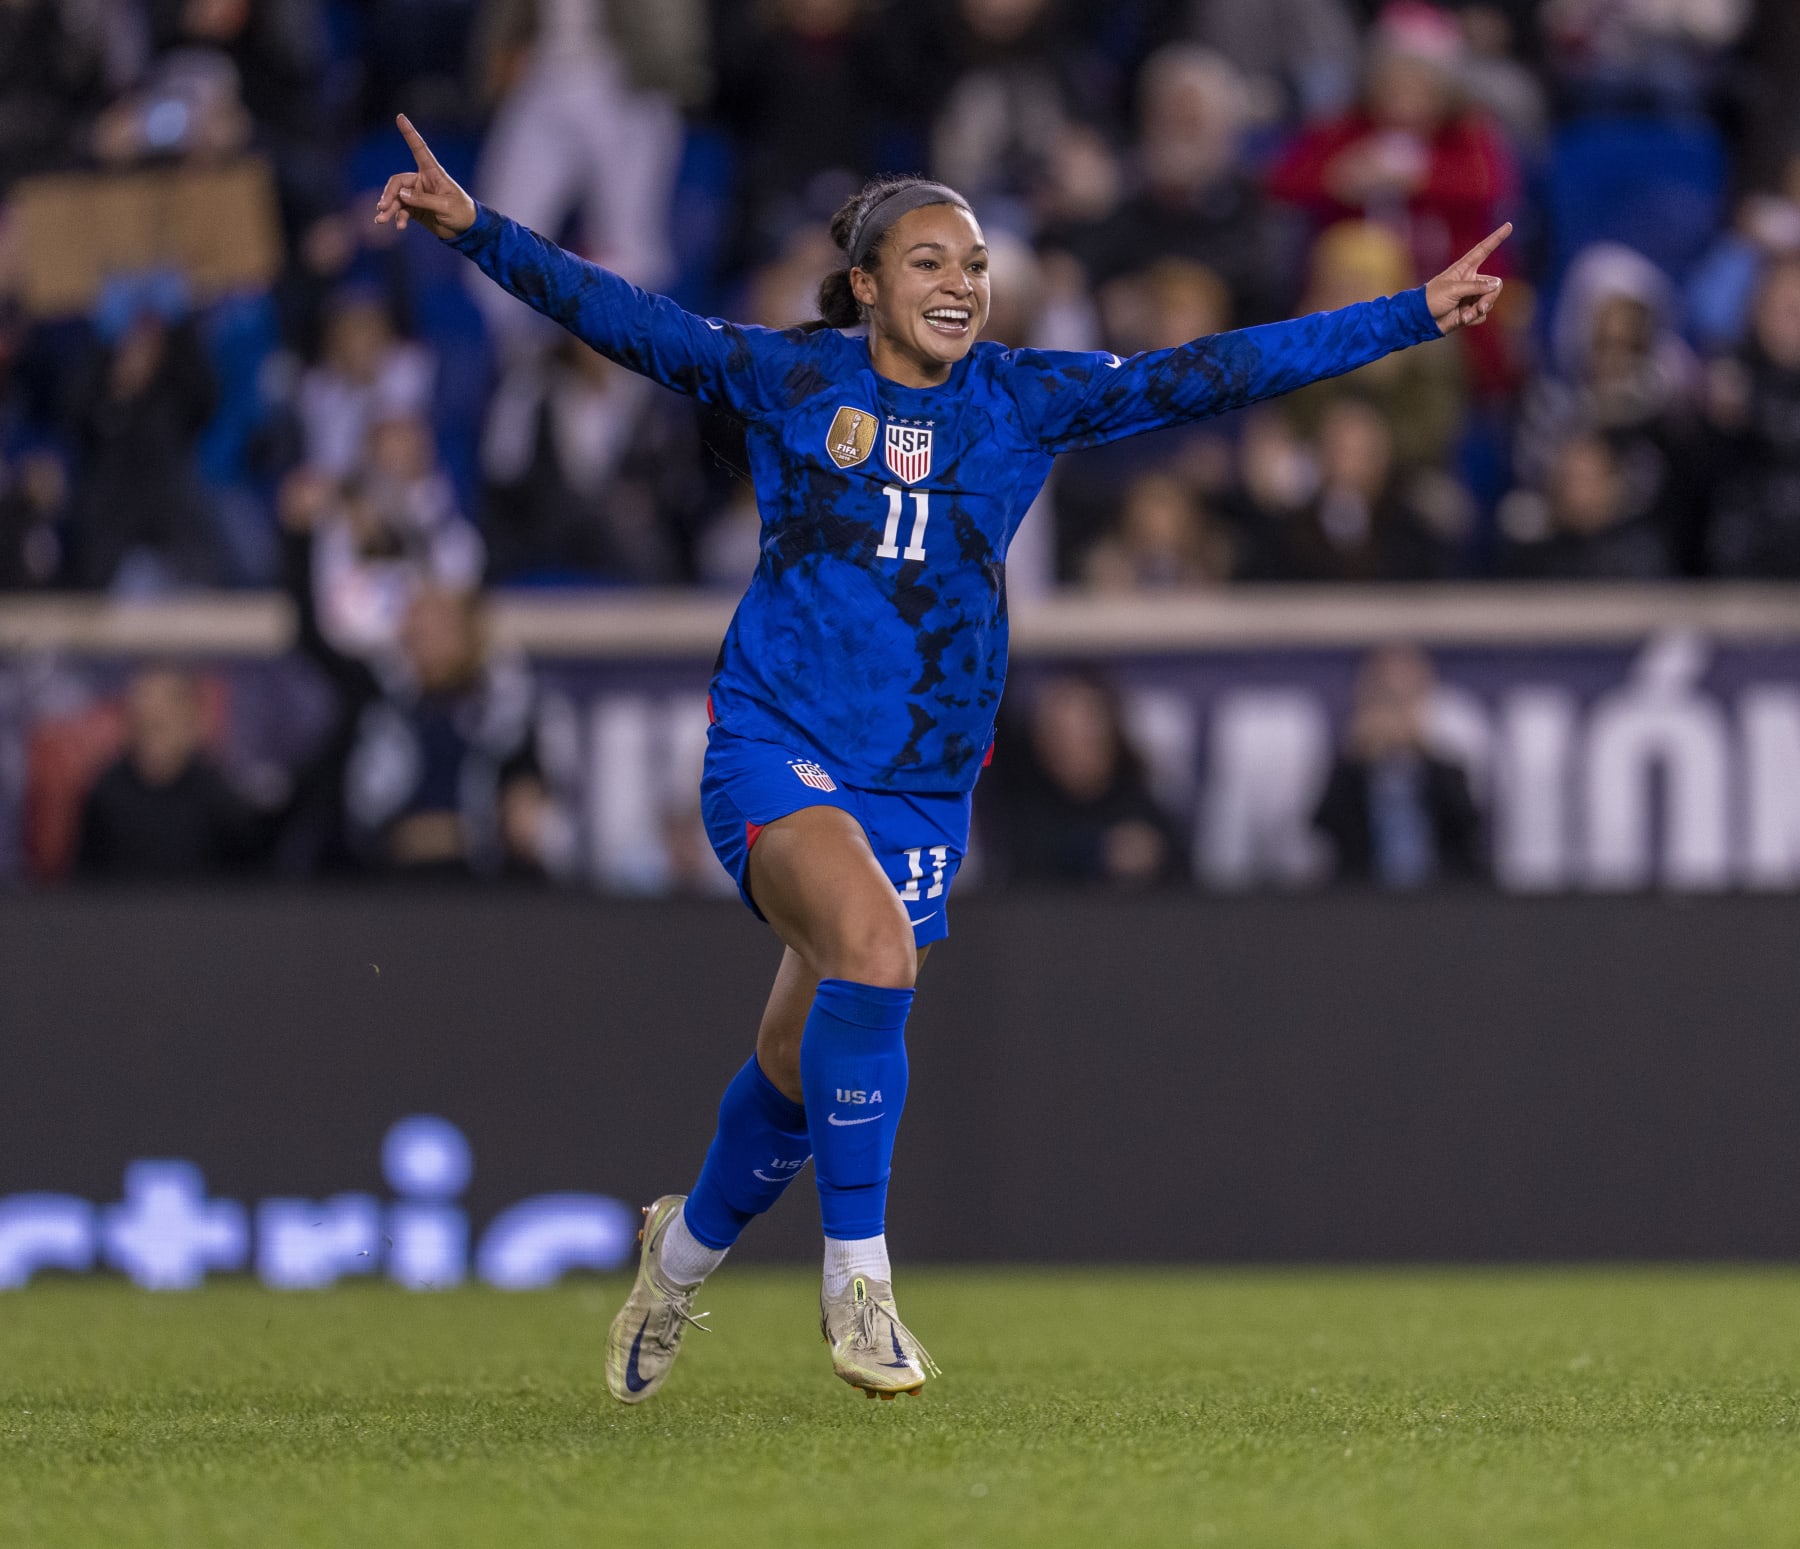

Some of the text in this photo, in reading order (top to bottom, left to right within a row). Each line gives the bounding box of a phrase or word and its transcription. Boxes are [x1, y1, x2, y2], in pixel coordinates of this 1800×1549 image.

[837, 443, 857, 456] FIFA
[888, 427, 929, 453] USA
[877, 484, 929, 561] 11
[900, 845, 949, 901] 11
[836, 1088, 883, 1105] USA
[770, 1158, 802, 1169] US
